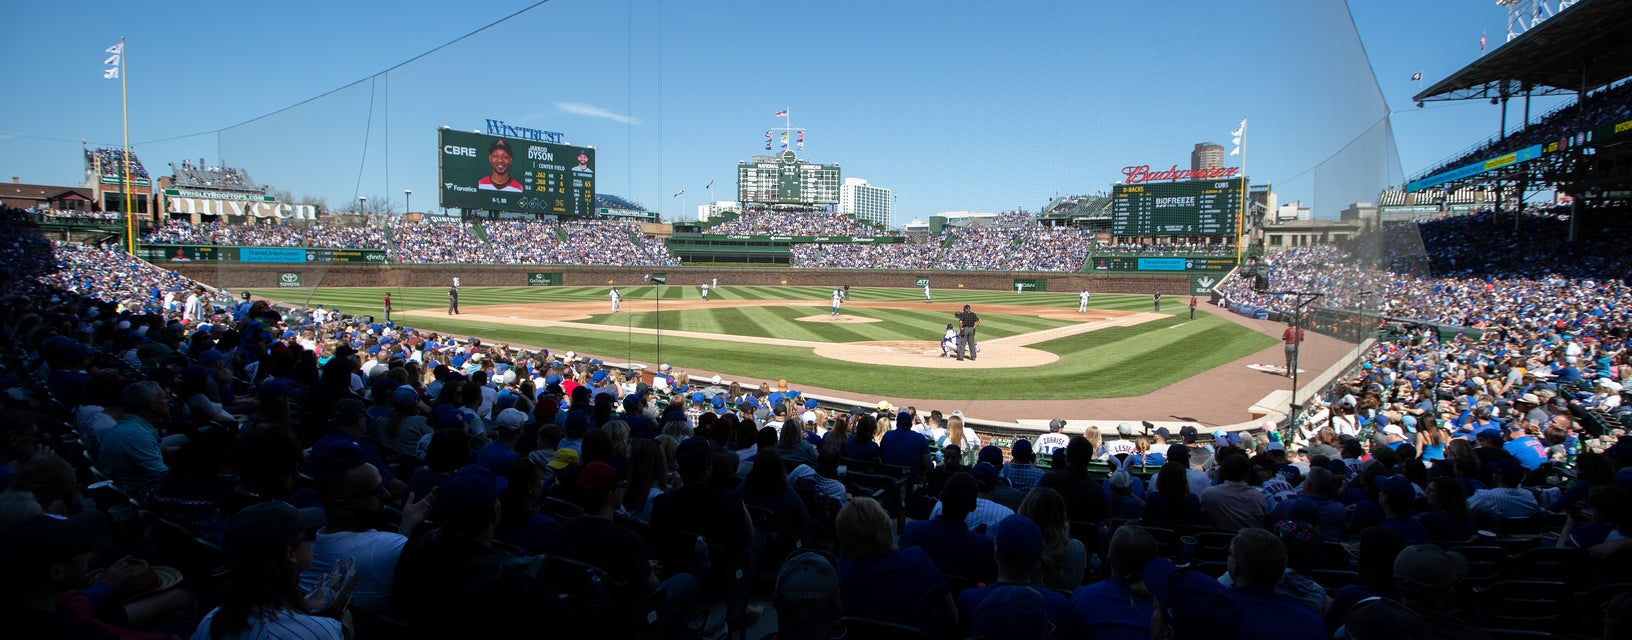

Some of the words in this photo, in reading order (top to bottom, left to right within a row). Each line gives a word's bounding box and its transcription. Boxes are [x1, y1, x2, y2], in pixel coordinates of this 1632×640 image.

[486, 119, 564, 143] WINTRUST
[444, 145, 476, 157] CBRE
[528, 150, 553, 161] DYSON
[1121, 165, 1239, 184] Budweiser
[453, 184, 477, 193] Fanatics
[172, 197, 317, 220] nuveen
